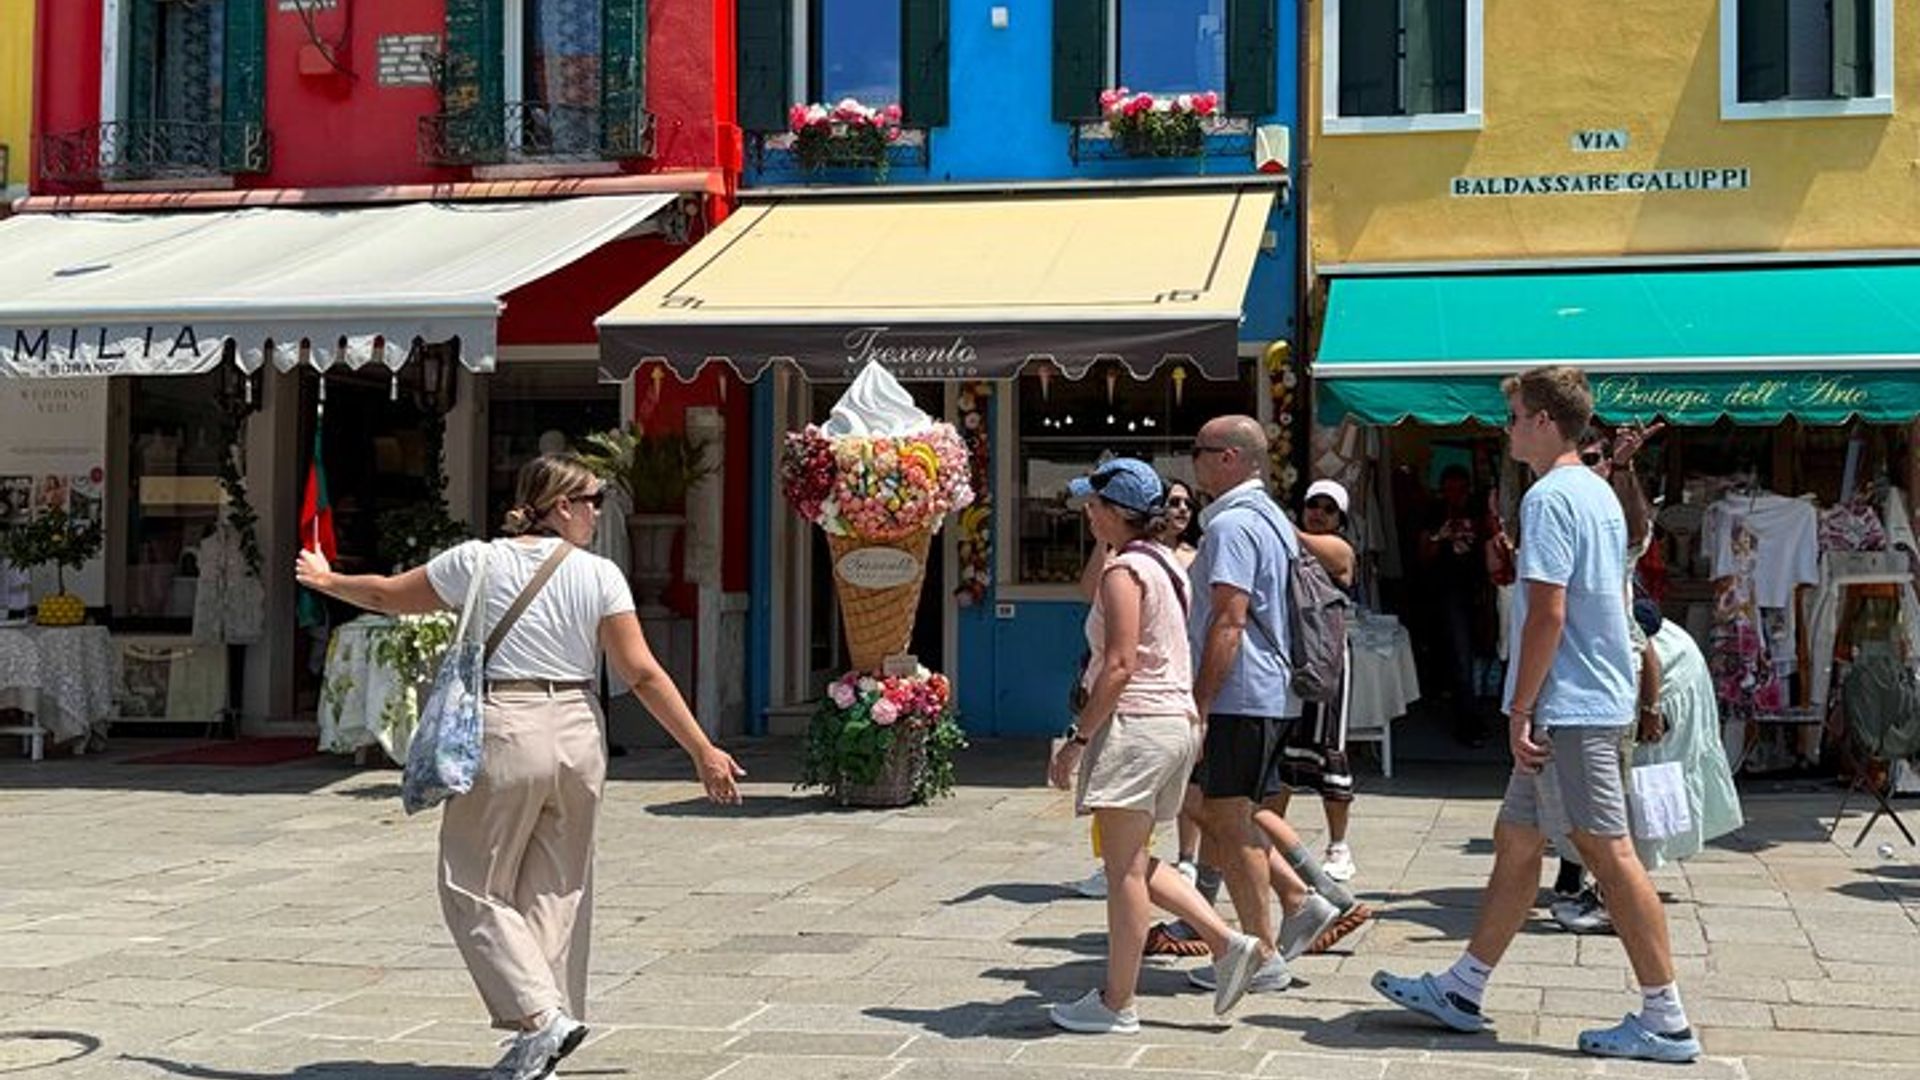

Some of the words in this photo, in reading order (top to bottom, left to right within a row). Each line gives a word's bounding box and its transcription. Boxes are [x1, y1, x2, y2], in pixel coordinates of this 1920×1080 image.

[1578, 132, 1621, 150] VIA
[1455, 175, 1619, 195] BALDASSARE
[1627, 168, 1747, 190] GALUPPI
[13, 325, 200, 361] MILIA
[914, 366, 977, 377] GELATO
[1597, 374, 1711, 416] Bottega
[1789, 373, 1868, 406] Arte
